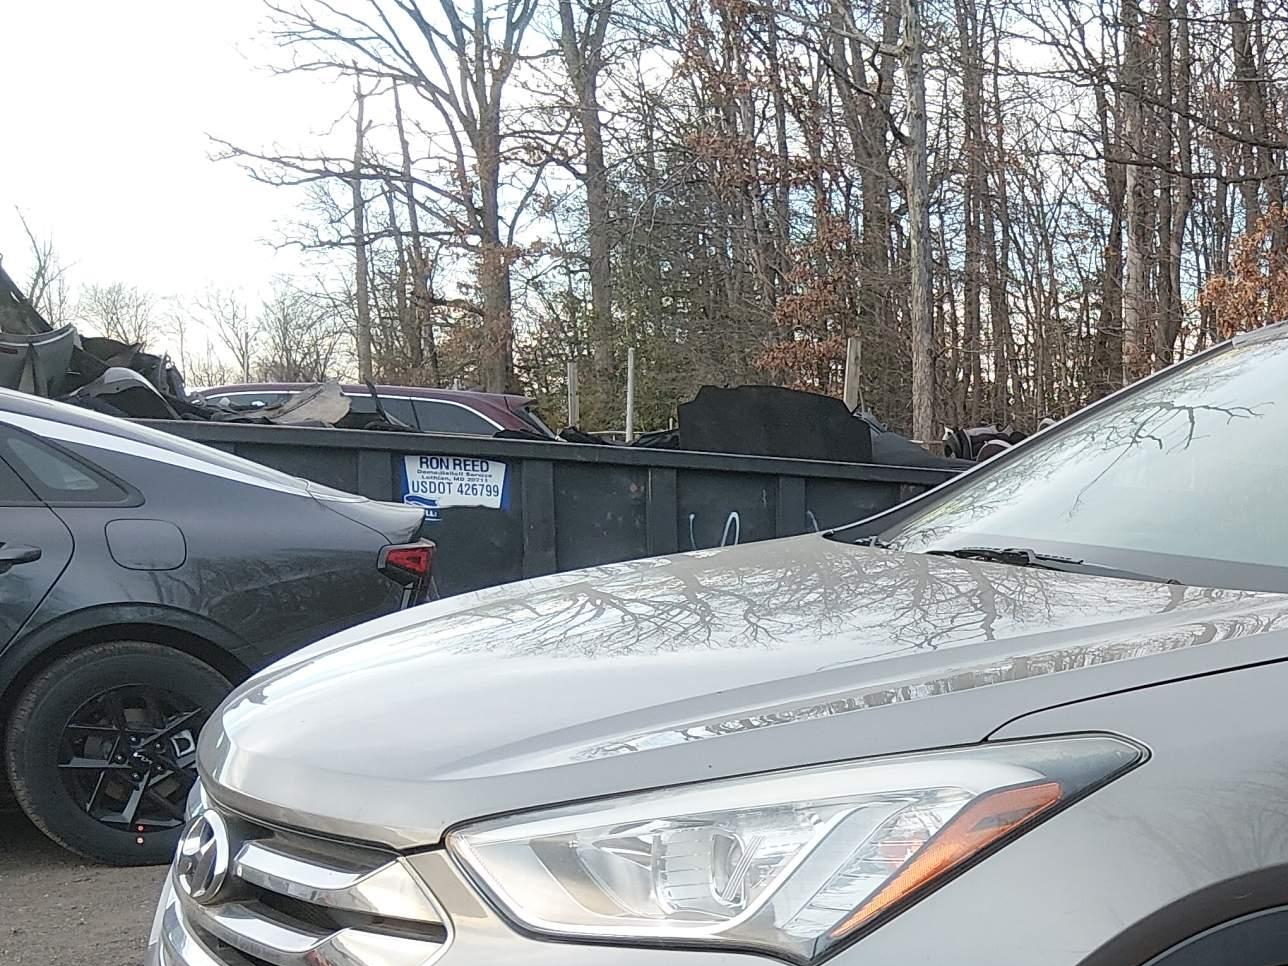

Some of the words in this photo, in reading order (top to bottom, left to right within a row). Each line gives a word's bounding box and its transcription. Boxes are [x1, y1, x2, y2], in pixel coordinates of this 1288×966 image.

[419, 456, 449, 470] RON
[453, 458, 490, 473] REED
[411, 480, 453, 495] USDOT
[457, 483, 500, 497] 426799
